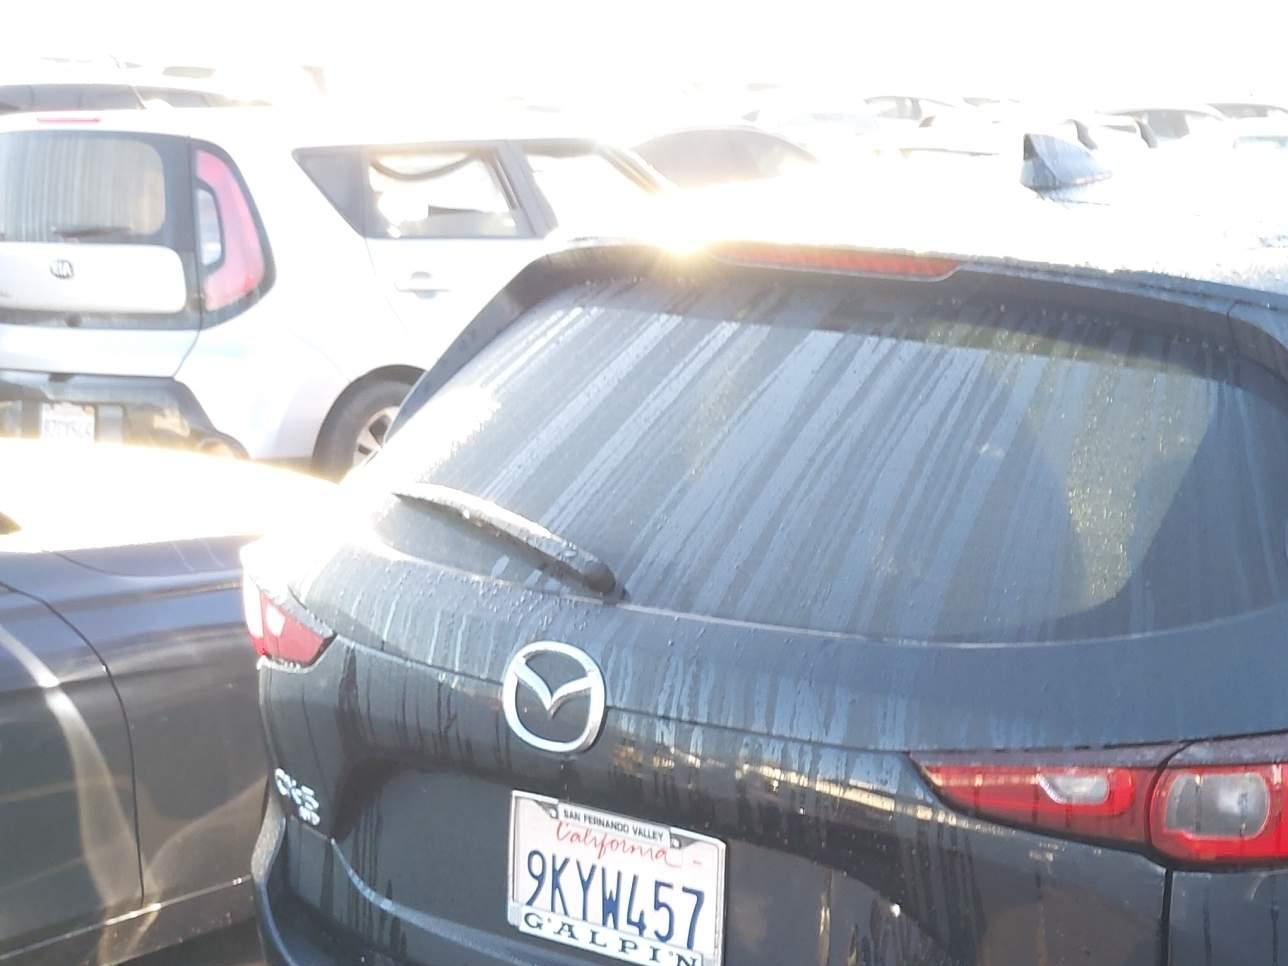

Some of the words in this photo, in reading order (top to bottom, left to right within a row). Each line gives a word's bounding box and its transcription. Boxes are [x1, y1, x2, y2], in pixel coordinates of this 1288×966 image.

[556, 820, 681, 868] California
[563, 808, 581, 821] SAN
[583, 813, 629, 834] FERNANDO
[631, 827, 665, 842] VALLEY
[527, 849, 705, 950] 9KYW457
